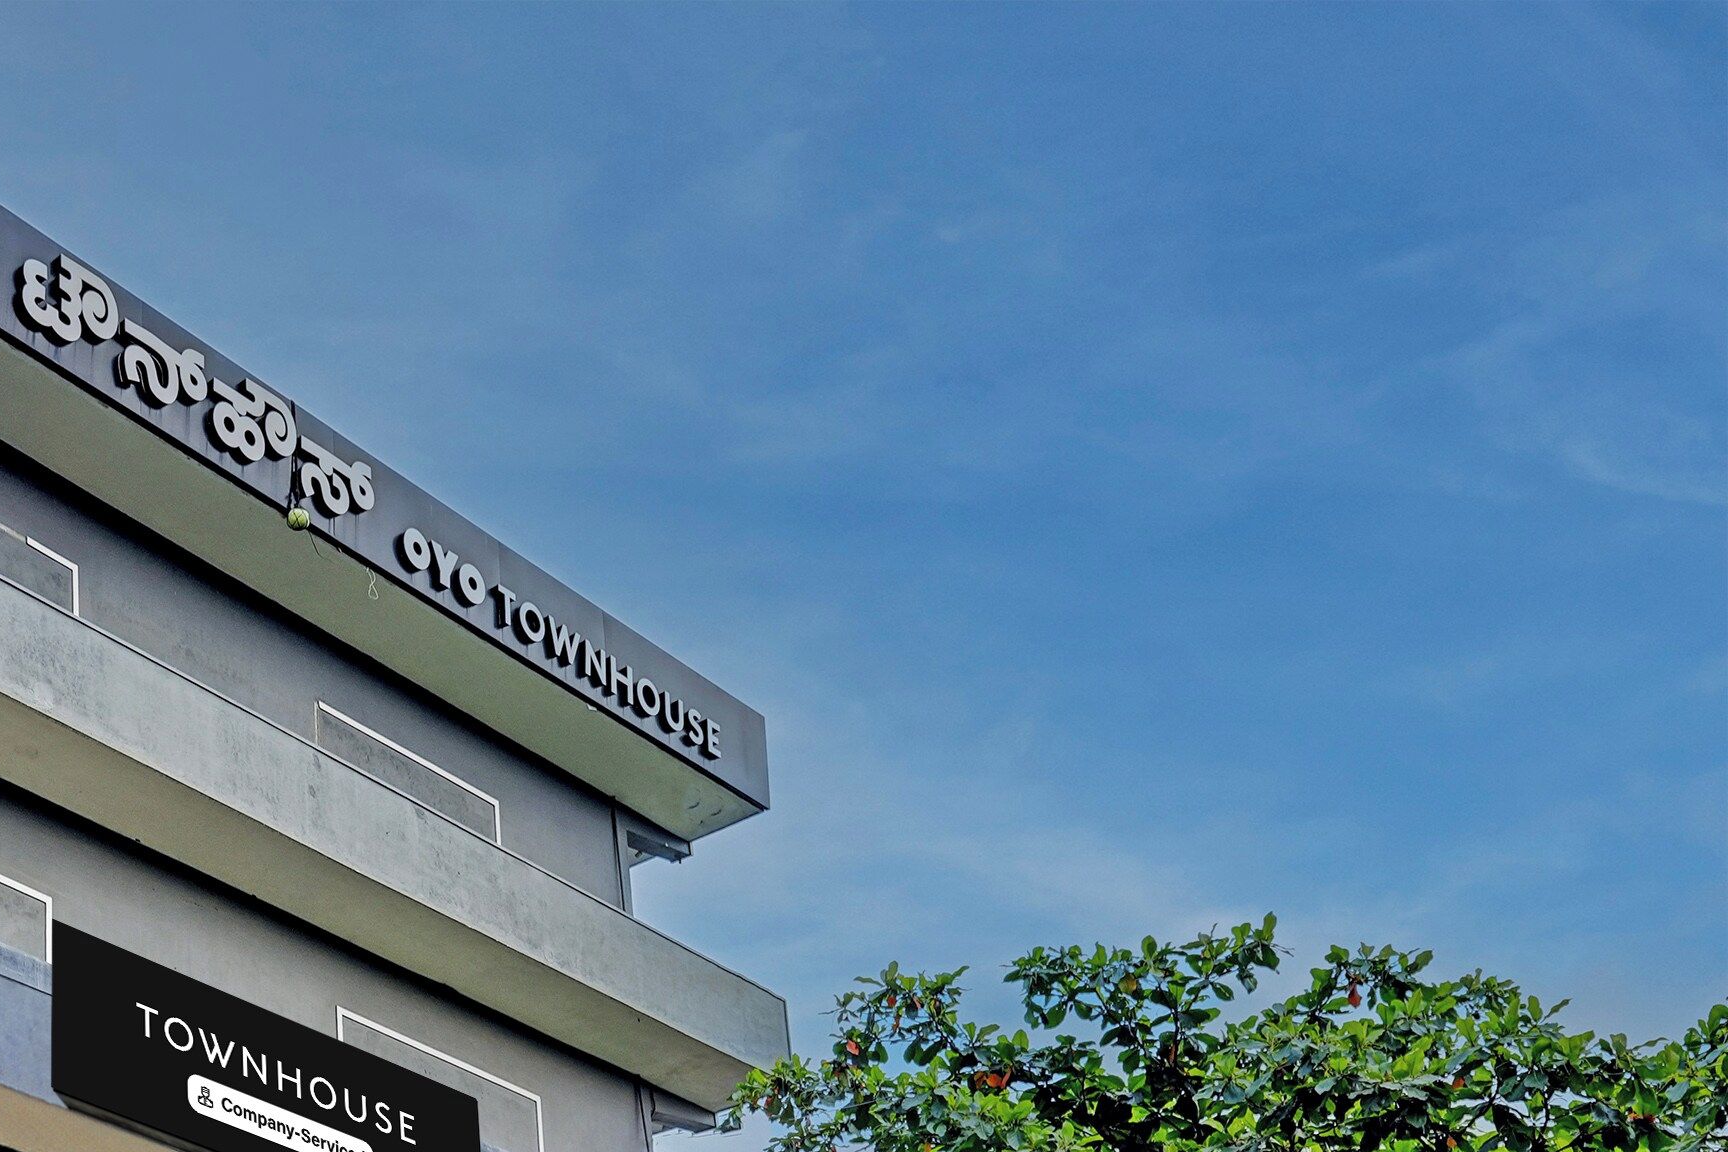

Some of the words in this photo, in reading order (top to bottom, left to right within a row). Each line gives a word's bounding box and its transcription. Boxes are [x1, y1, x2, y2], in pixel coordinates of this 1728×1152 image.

[403, 527, 487, 606] OYO
[496, 584, 723, 759] TOWNHOUSE
[135, 1001, 418, 1147] TOWNHOUSE
